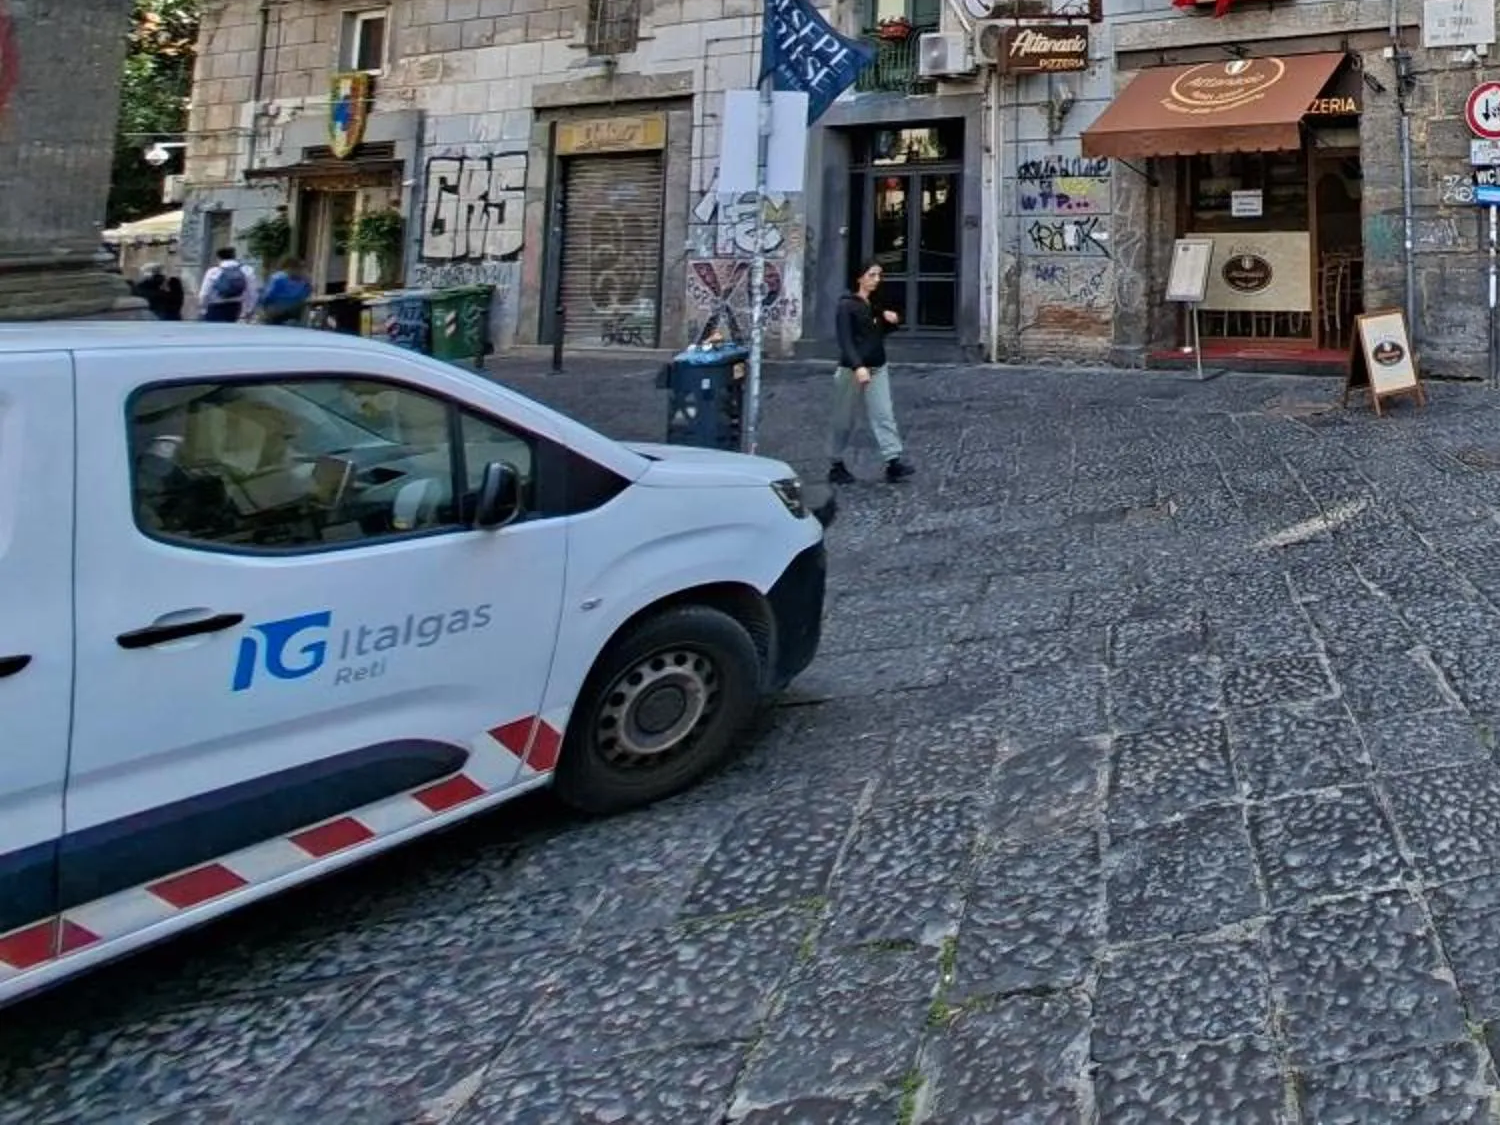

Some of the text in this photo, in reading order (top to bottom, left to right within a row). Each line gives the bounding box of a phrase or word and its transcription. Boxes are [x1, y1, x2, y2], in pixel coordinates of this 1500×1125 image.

[1306, 97, 1356, 114] ZERIA
[339, 604, 492, 660] Italgas
[333, 658, 387, 686] Reti
